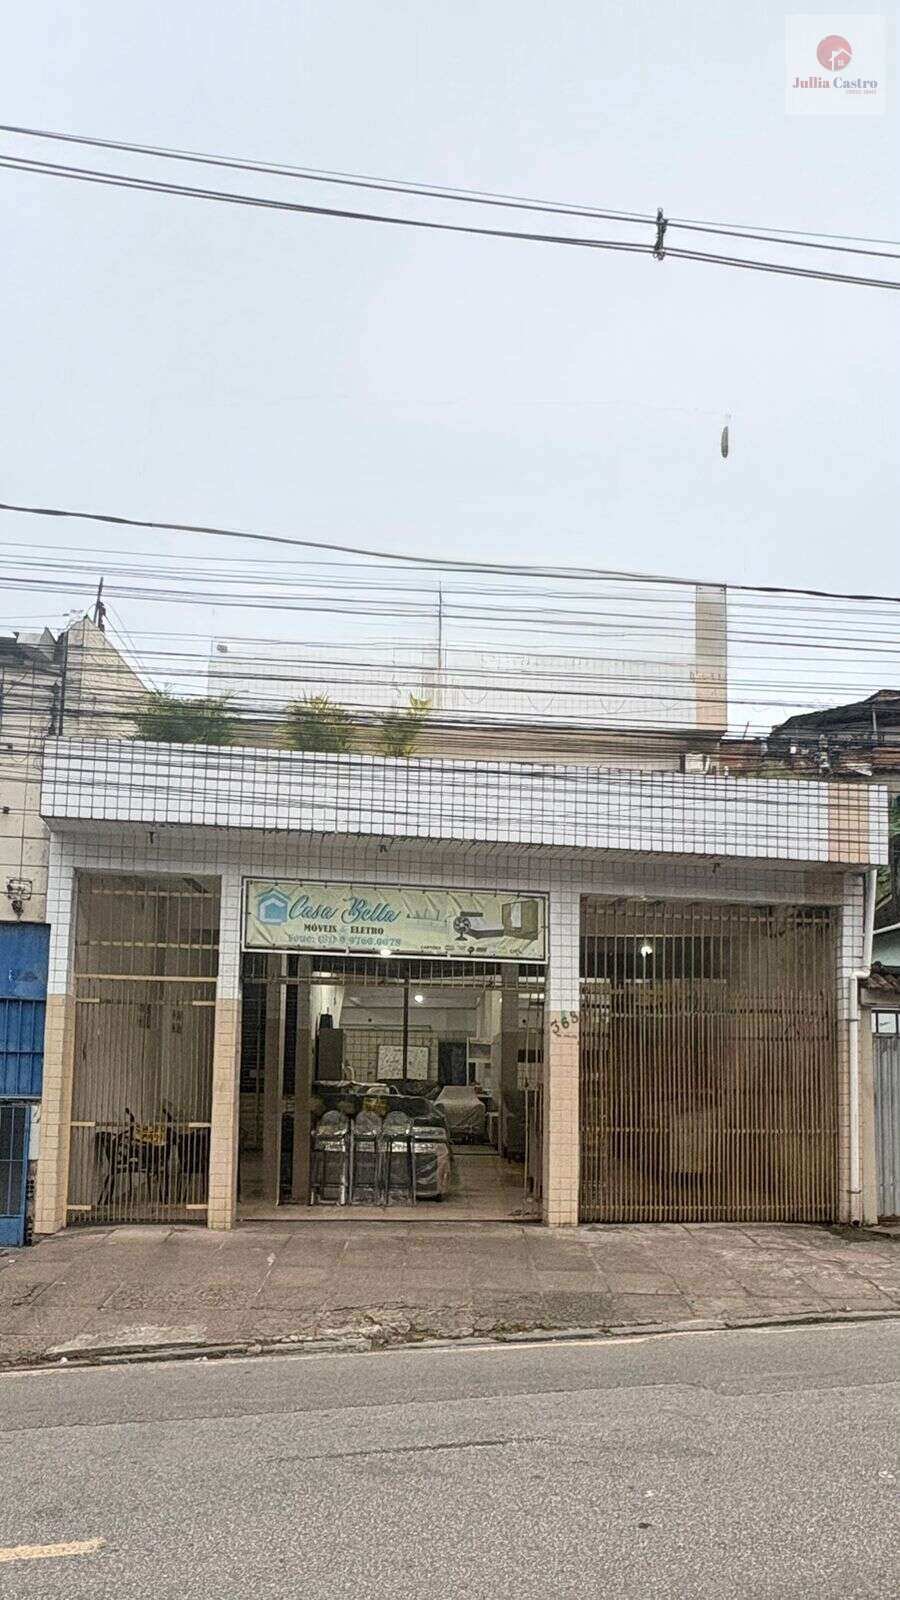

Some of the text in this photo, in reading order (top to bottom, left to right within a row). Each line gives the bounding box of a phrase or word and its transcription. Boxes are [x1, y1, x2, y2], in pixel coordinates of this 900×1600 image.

[288, 895, 401, 924] Casa Bella
[350, 926, 384, 935] ELETRO
